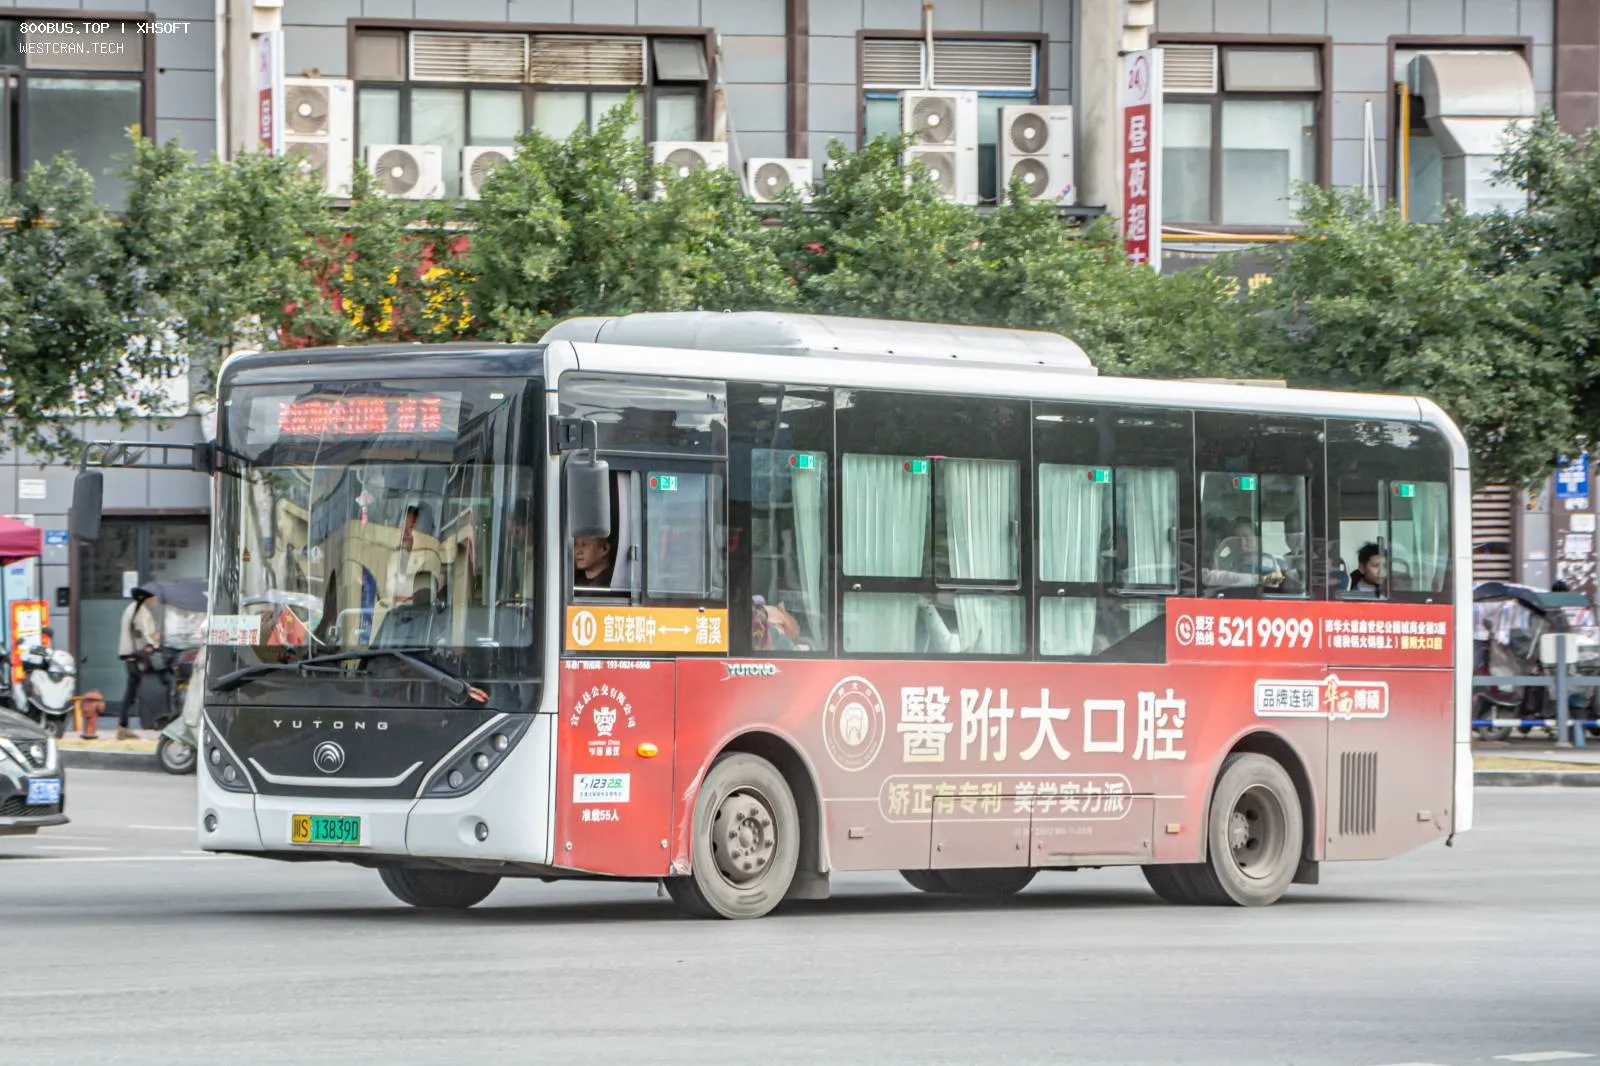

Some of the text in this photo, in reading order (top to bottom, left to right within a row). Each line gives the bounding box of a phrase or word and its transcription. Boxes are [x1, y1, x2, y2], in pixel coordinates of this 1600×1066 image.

[574, 613, 594, 642] 10
[603, 614, 722, 645] 宣汉老职中 清溪
[1218, 616, 1314, 648] 521 9999
[727, 663, 777, 677] YUTONG
[1263, 688, 1314, 708] 品牌连锁
[273, 720, 388, 730] YUTONG
[897, 686, 1188, 764] 醫附大口腔
[888, 781, 1126, 816] 矫正有专利 美学实力派
